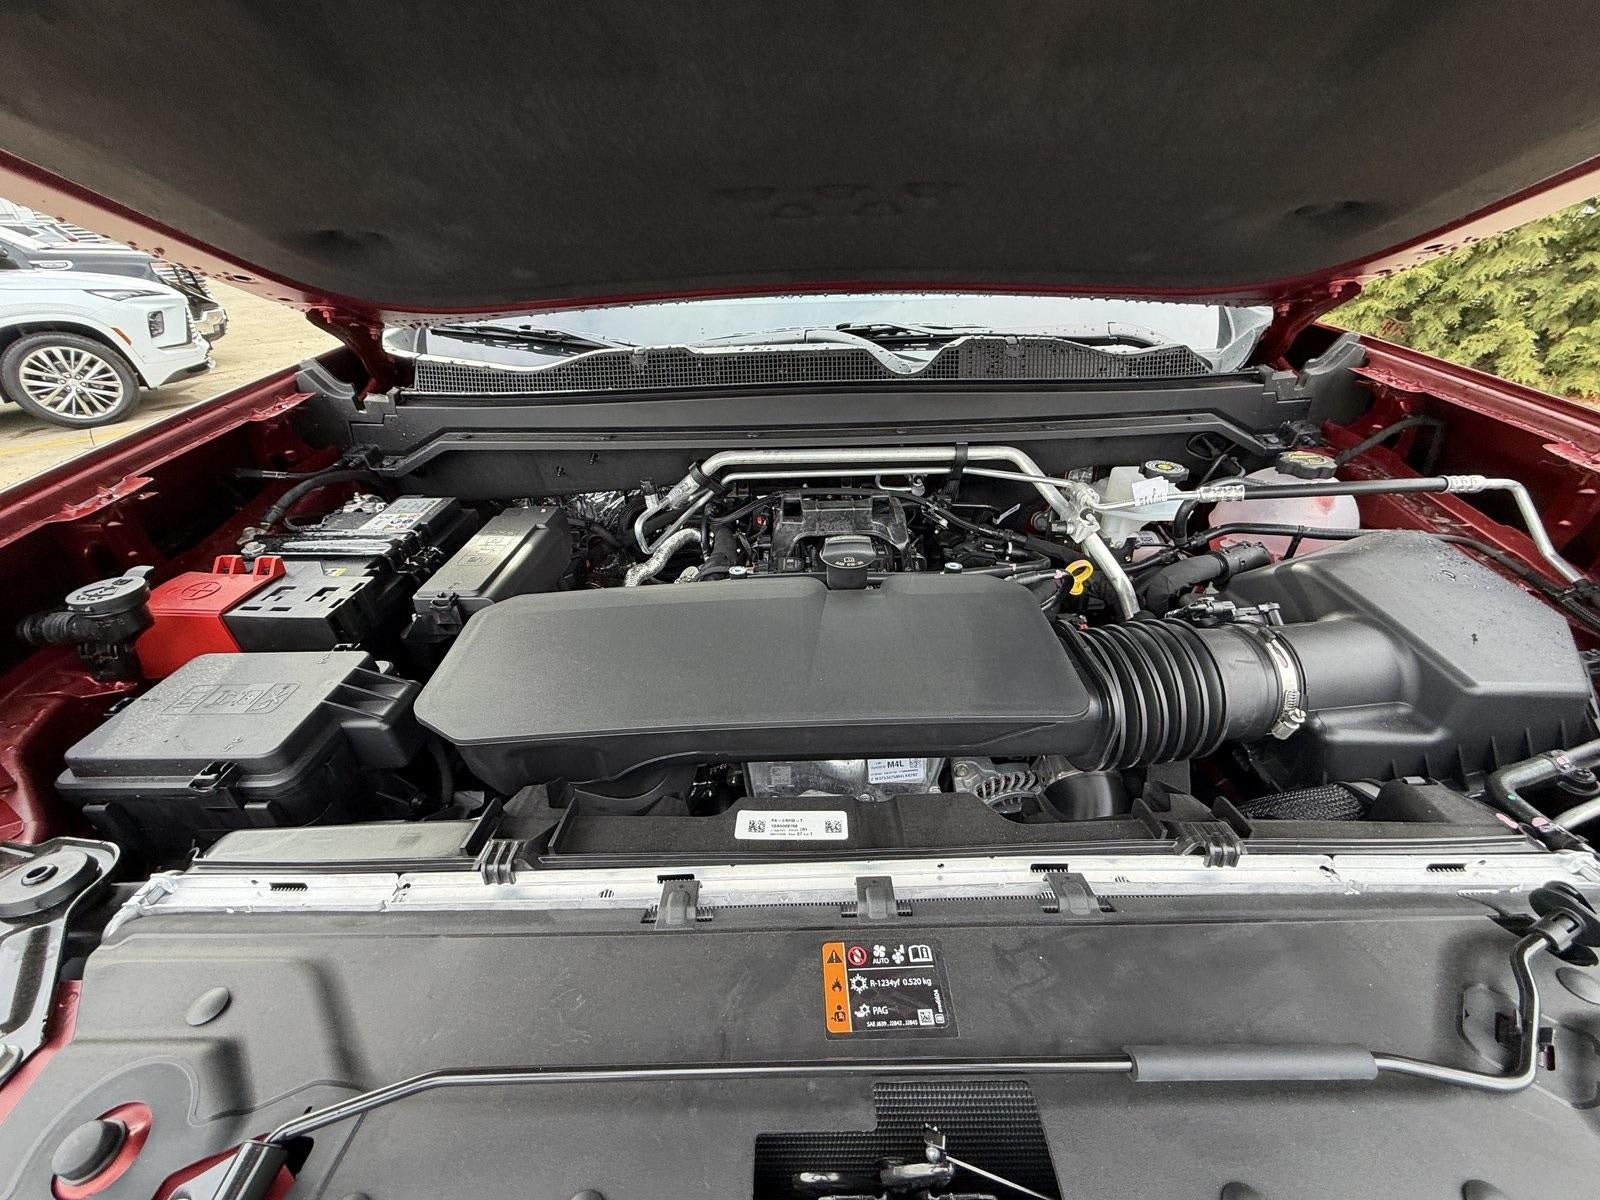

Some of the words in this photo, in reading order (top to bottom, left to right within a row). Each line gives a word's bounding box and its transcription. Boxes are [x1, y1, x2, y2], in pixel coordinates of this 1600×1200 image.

[887, 760, 905, 769] M4L
[872, 957, 890, 965] AUTO
[869, 978, 900, 988] R-1234yf
[902, 977, 922, 986] 0.520
[922, 977, 932, 987] kg
[872, 1006, 889, 1015] PAG
